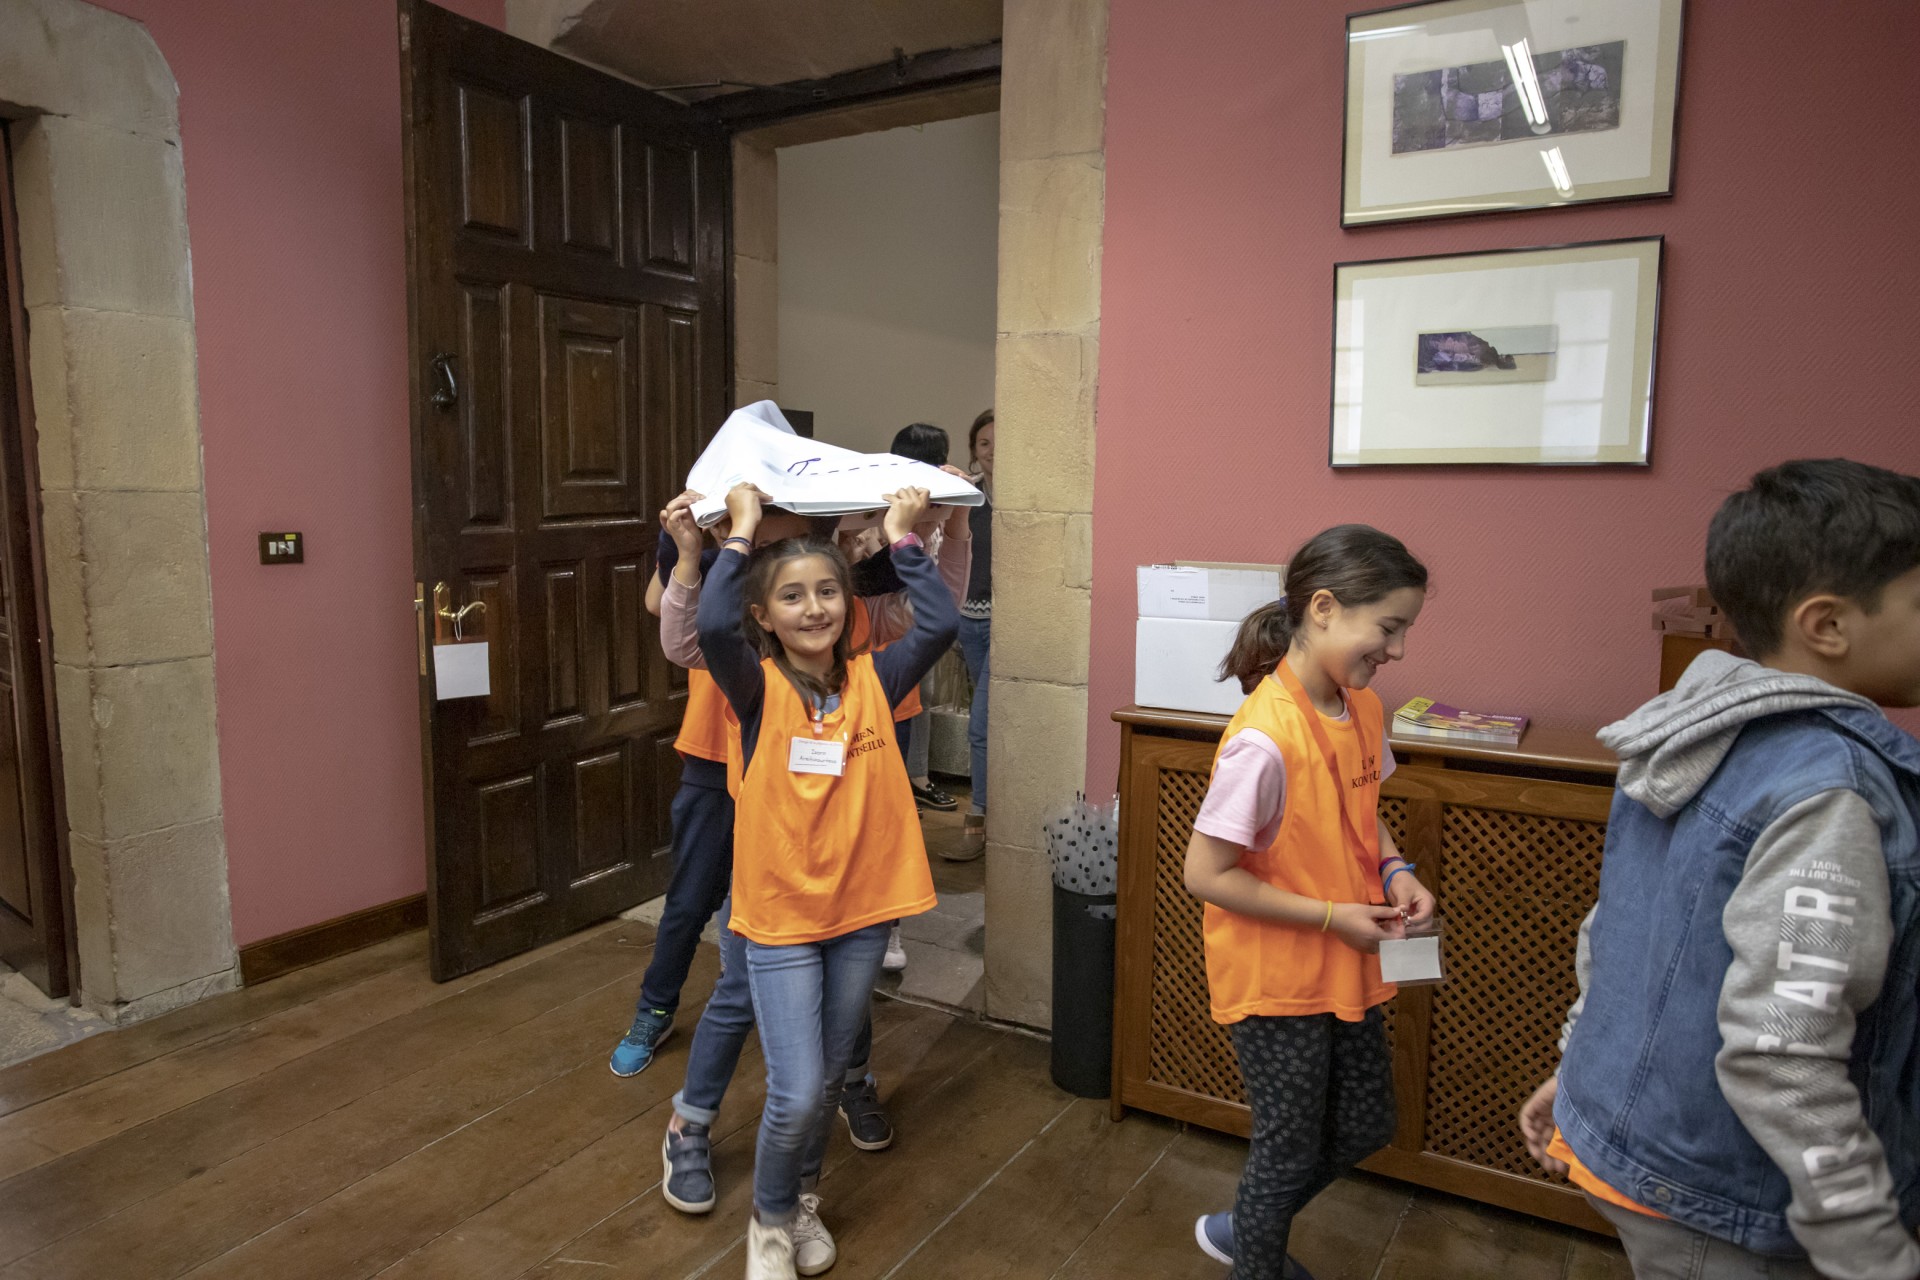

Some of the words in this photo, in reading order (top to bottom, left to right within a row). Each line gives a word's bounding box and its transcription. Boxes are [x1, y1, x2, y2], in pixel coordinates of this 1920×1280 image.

[1811, 860, 1842, 873] MOVE
[1789, 868, 1806, 878] THE
[1807, 869, 1828, 880] OUT
